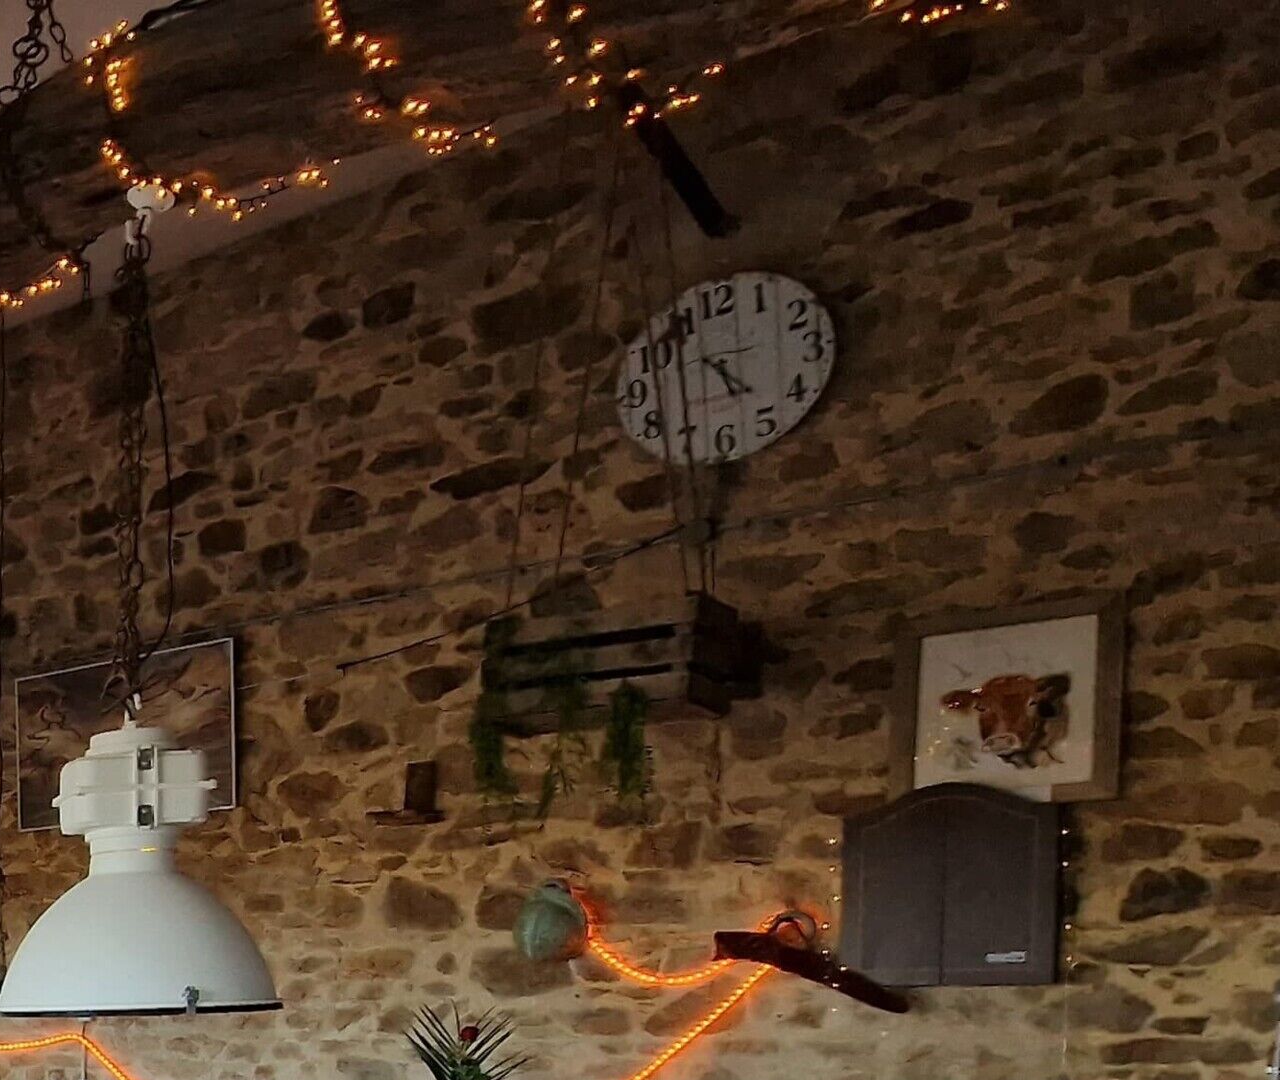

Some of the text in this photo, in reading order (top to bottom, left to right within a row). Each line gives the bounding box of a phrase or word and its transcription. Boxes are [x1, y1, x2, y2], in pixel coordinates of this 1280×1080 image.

[702, 284, 734, 320] 12
[753, 283, 767, 313] 1
[787, 299, 808, 331] 2
[640, 340, 673, 374] 10
[802, 331, 825, 363] 3
[625, 379, 648, 409] 9
[787, 373, 807, 402] 4
[643, 410, 661, 440] 8
[756, 405, 778, 437] 5
[714, 424, 736, 454] 6
